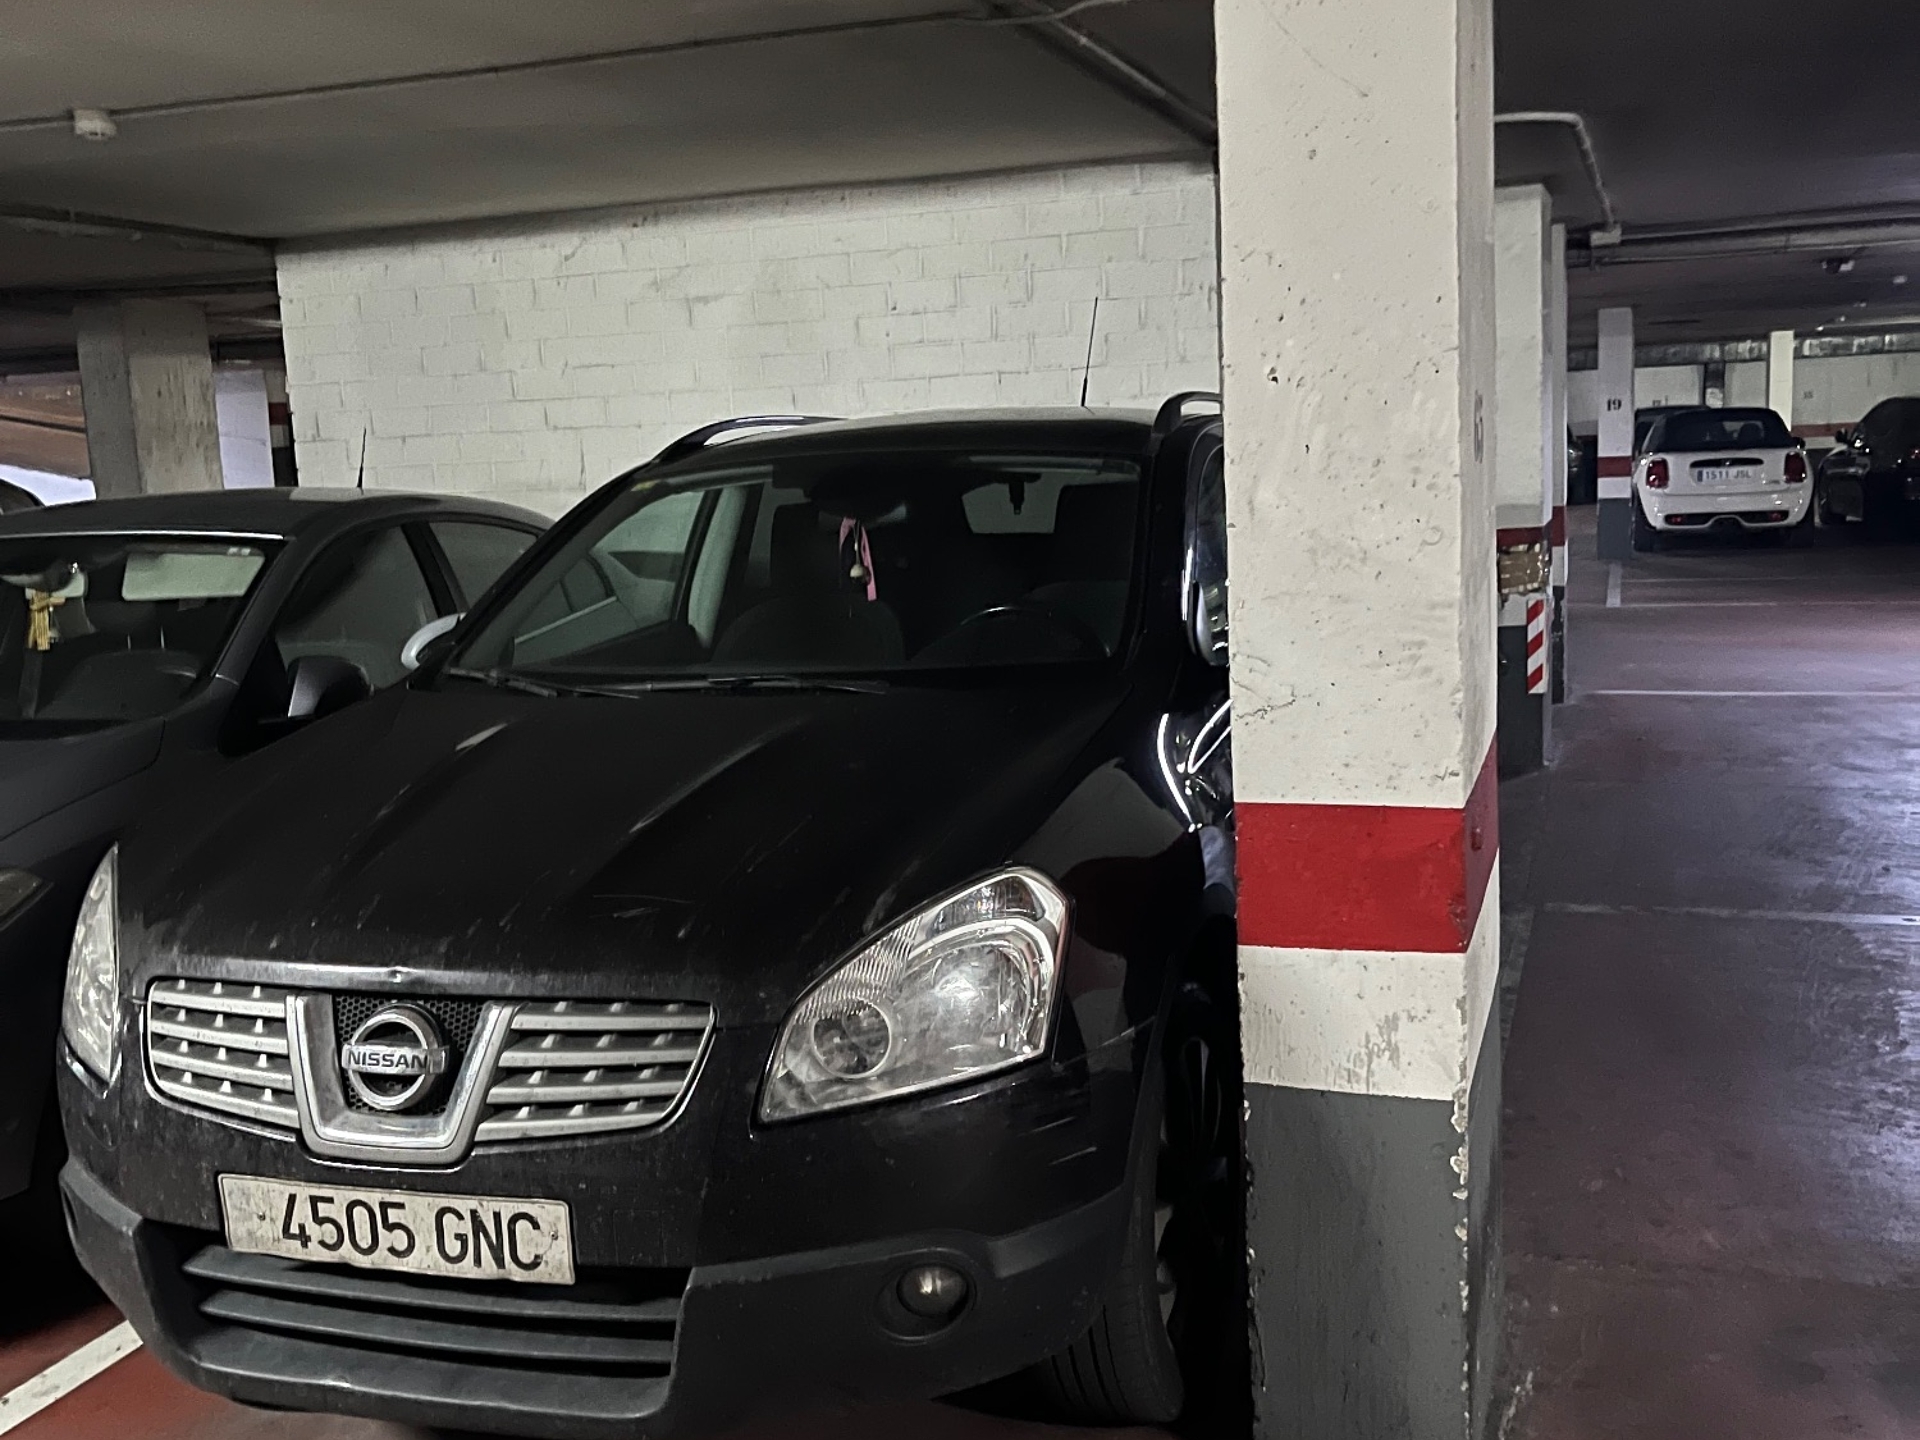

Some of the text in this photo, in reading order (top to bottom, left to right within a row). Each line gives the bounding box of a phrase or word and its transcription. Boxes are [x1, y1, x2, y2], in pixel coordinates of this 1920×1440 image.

[1606, 398, 1622, 412] 19
[347, 1049, 428, 1069] NISSAN
[282, 1193, 542, 1271] 4505 GNC
